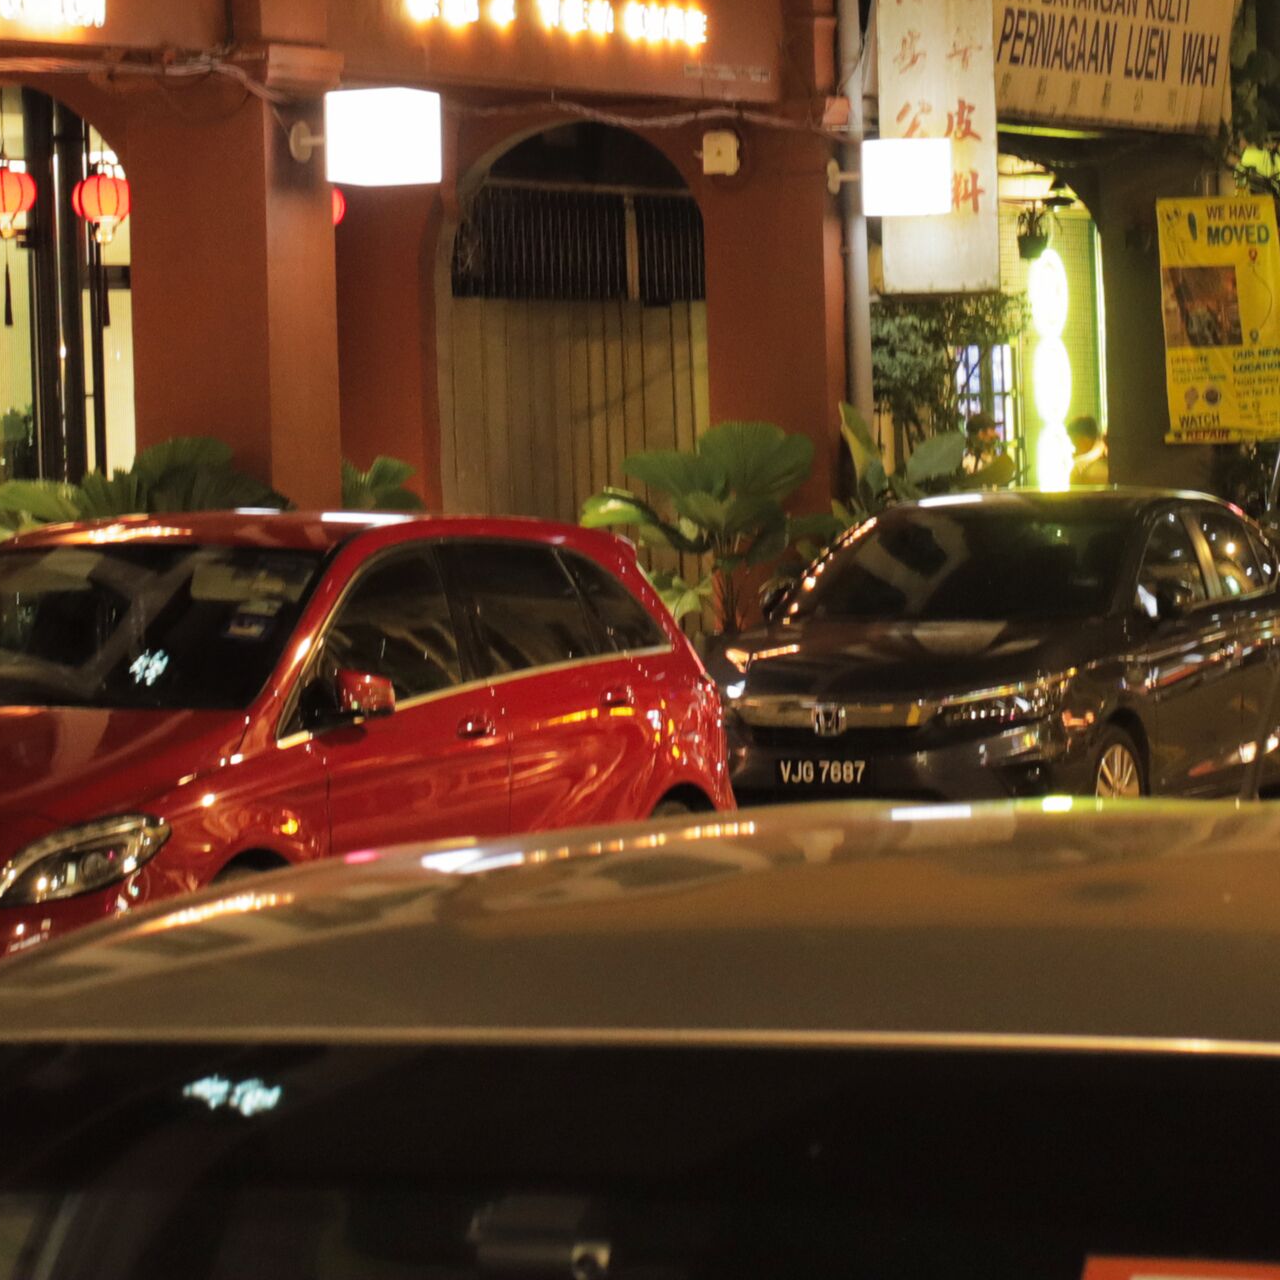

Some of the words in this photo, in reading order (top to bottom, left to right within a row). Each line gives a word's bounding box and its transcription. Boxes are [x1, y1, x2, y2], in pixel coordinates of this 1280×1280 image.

[996, 6, 1119, 76] PERNIAGAAN
[1123, 24, 1172, 83] LUEN
[1180, 30, 1220, 88] WAH
[1206, 204, 1224, 221] WE
[1228, 203, 1260, 220] HAVE
[1206, 224, 1270, 247] MOVED
[1179, 414, 1221, 429] WATCH
